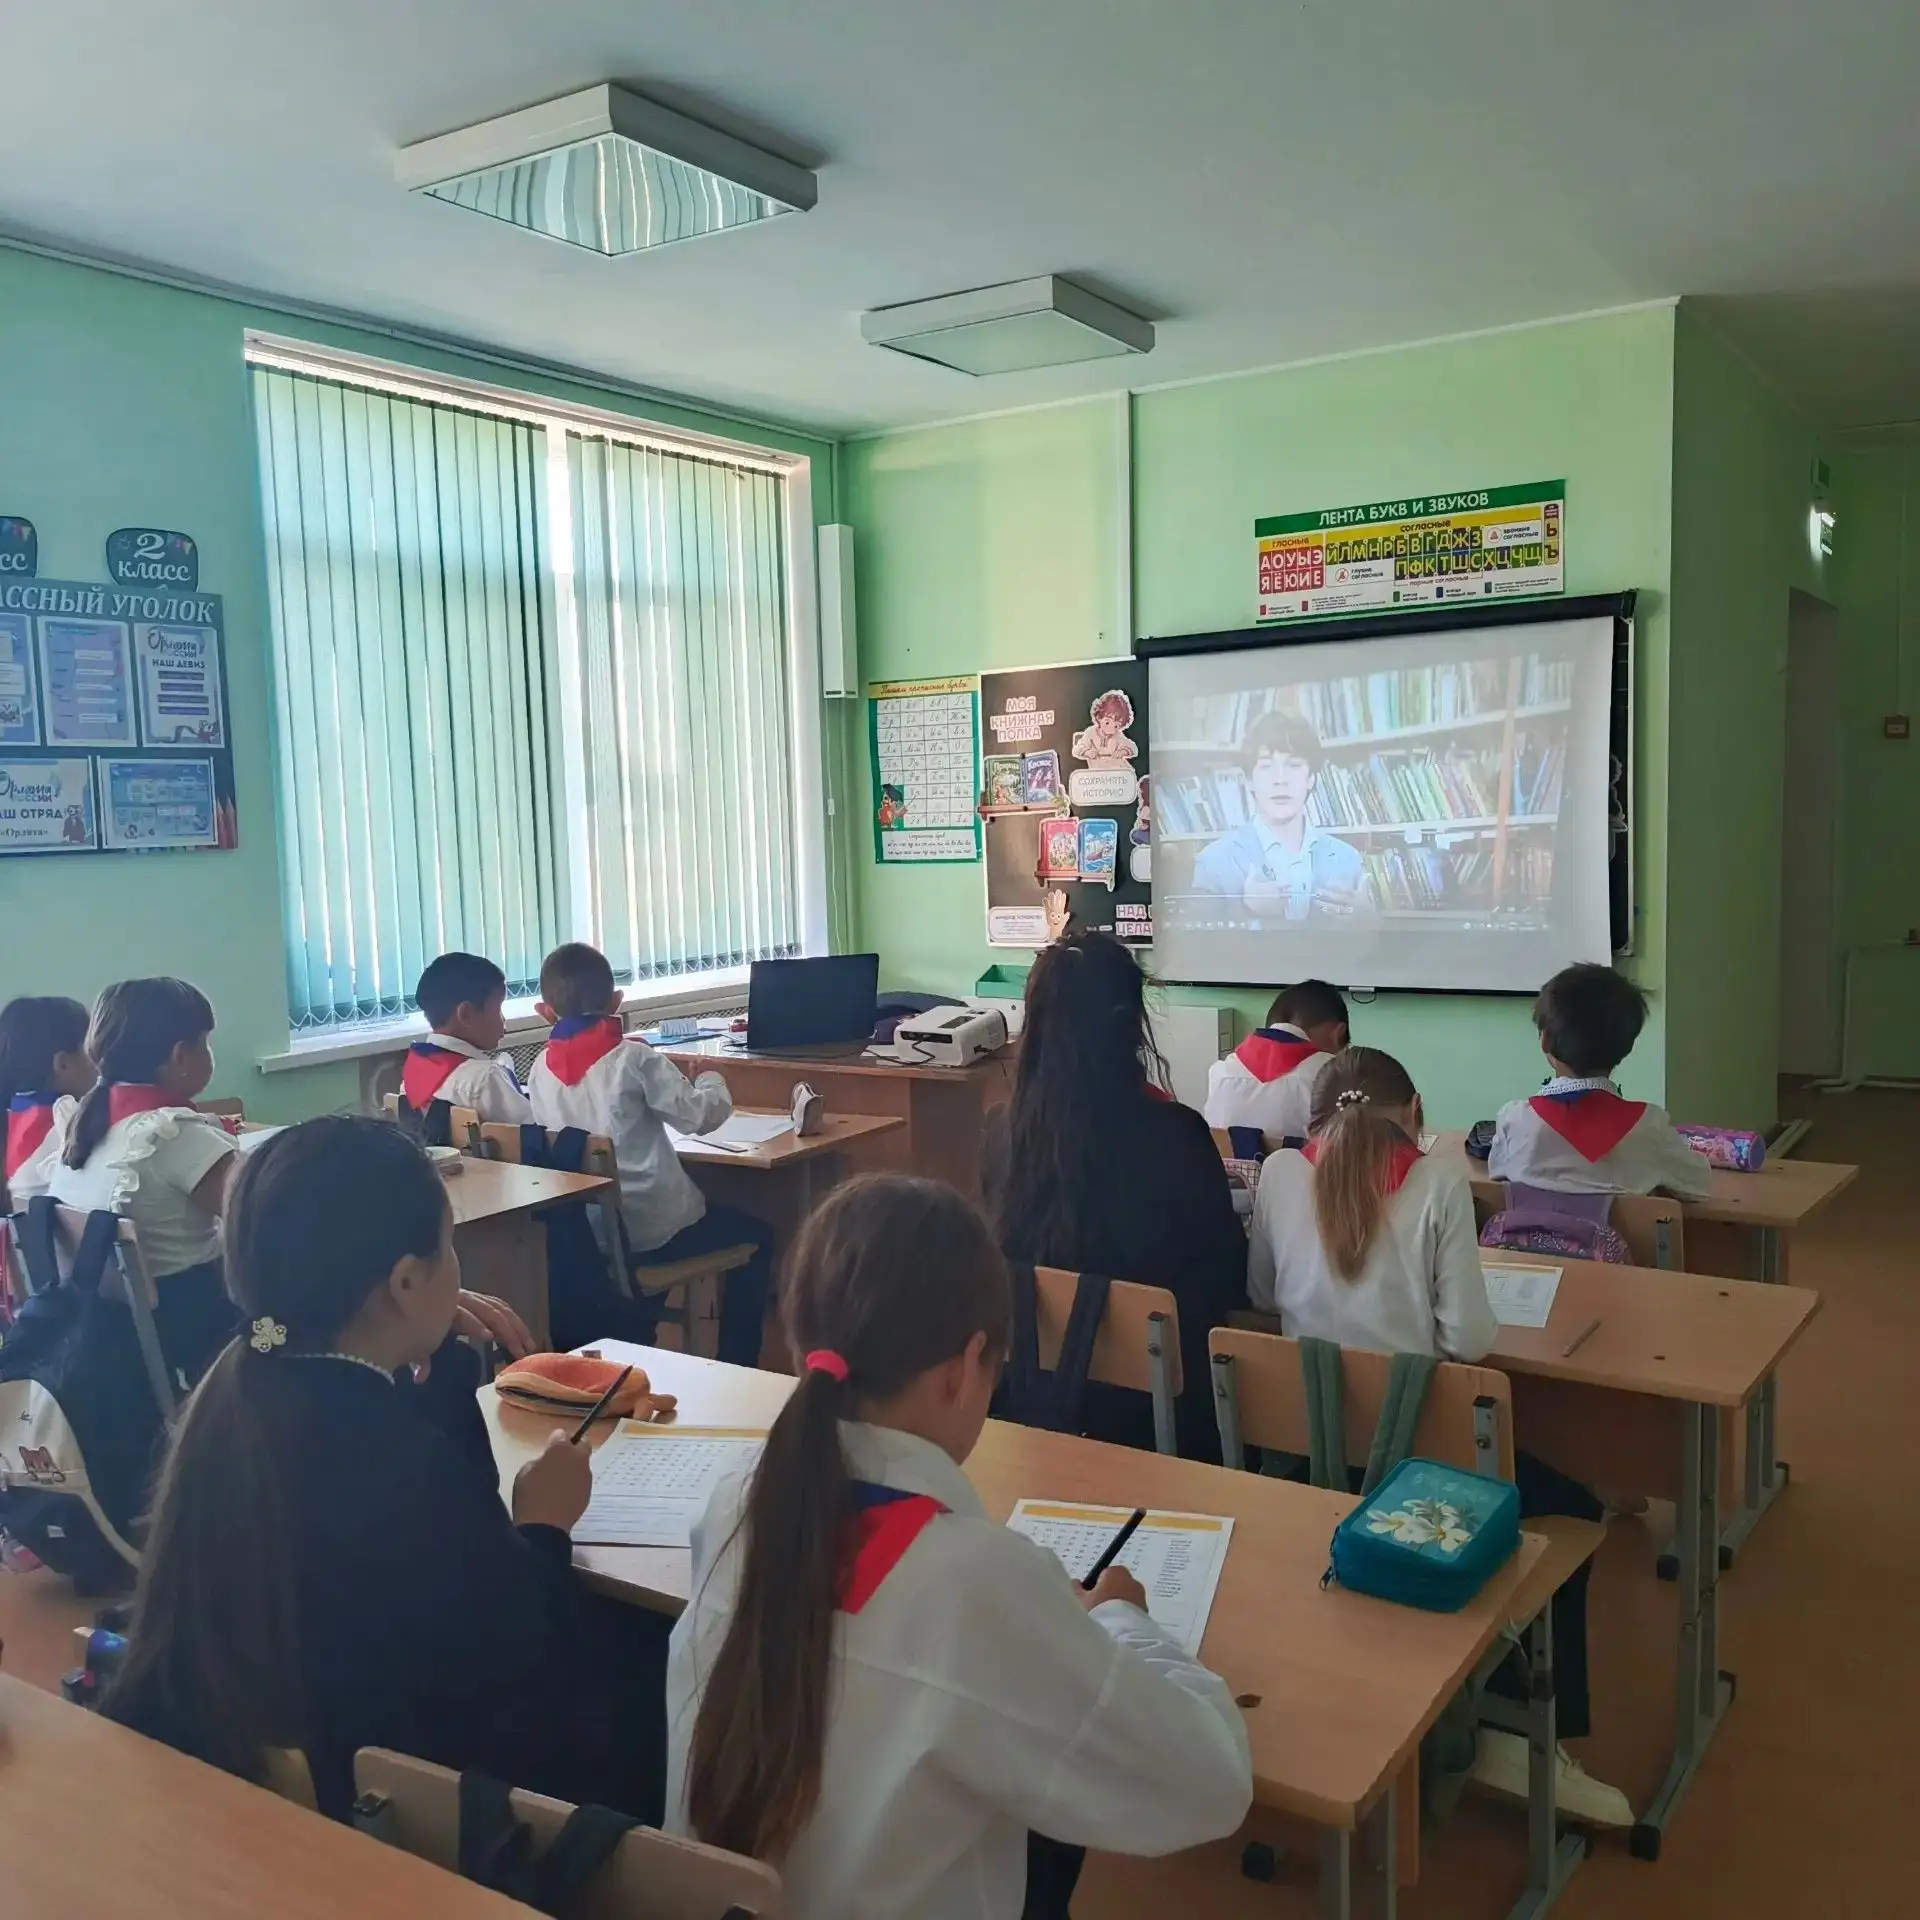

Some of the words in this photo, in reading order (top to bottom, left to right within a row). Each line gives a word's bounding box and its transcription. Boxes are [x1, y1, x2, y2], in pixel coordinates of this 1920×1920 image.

[1319, 508, 1365, 526] ЛЕНТА
[1369, 502, 1408, 520] БУКВ
[1412, 499, 1424, 515] И
[1428, 492, 1489, 513] ЗВУКОВ
[1400, 519, 1451, 532] согласные
[133, 533, 167, 560] 2
[1271, 538, 1310, 548] гласные
[118, 560, 191, 581] класс
[0, 586, 104, 615] ССНЫЙ
[111, 593, 216, 623] УГОЛОК
[152, 658, 175, 667] НАШ
[1007, 697, 1036, 711] МОЯ
[991, 712, 1053, 730] КНИЖНАЯ
[999, 727, 1041, 741] ПОЛКА
[20, 808, 63, 819] ОТРЯД
[1117, 905, 1145, 918] НАД
